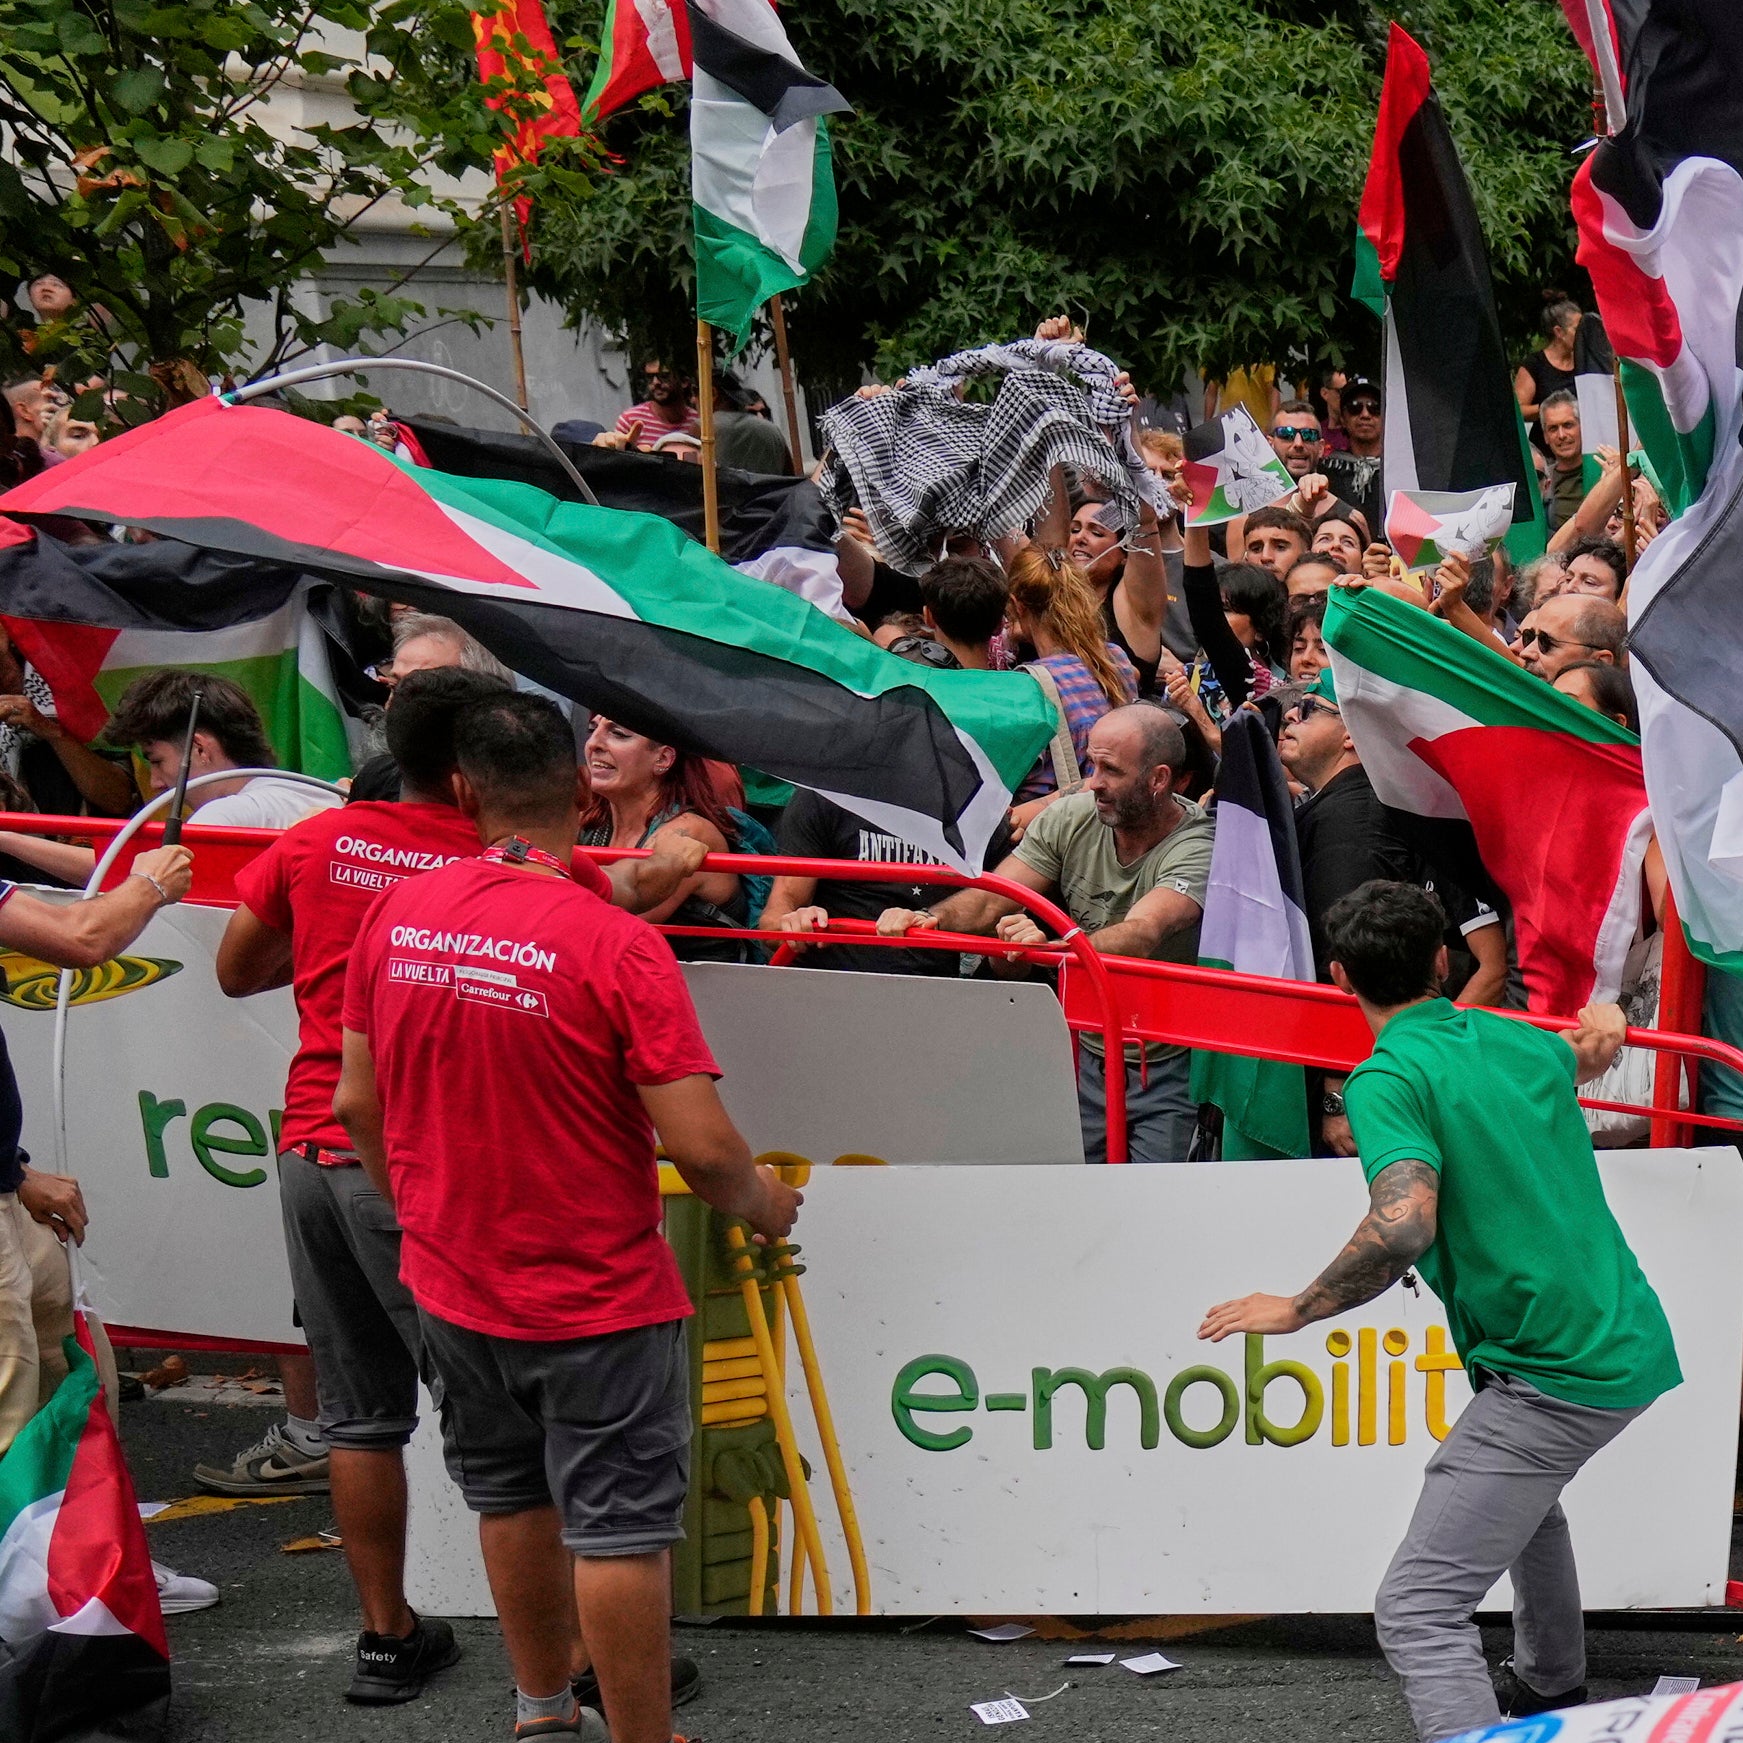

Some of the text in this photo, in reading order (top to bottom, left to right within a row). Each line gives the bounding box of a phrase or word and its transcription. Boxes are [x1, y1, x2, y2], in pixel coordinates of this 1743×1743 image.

[336, 866, 351, 881] LA
[390, 925, 557, 973] ORGANIZACIÓN
[391, 960, 403, 978] LA
[404, 963, 450, 983] VUELTA
[460, 982, 511, 1001] Carrefour
[137, 1088, 281, 1189] re
